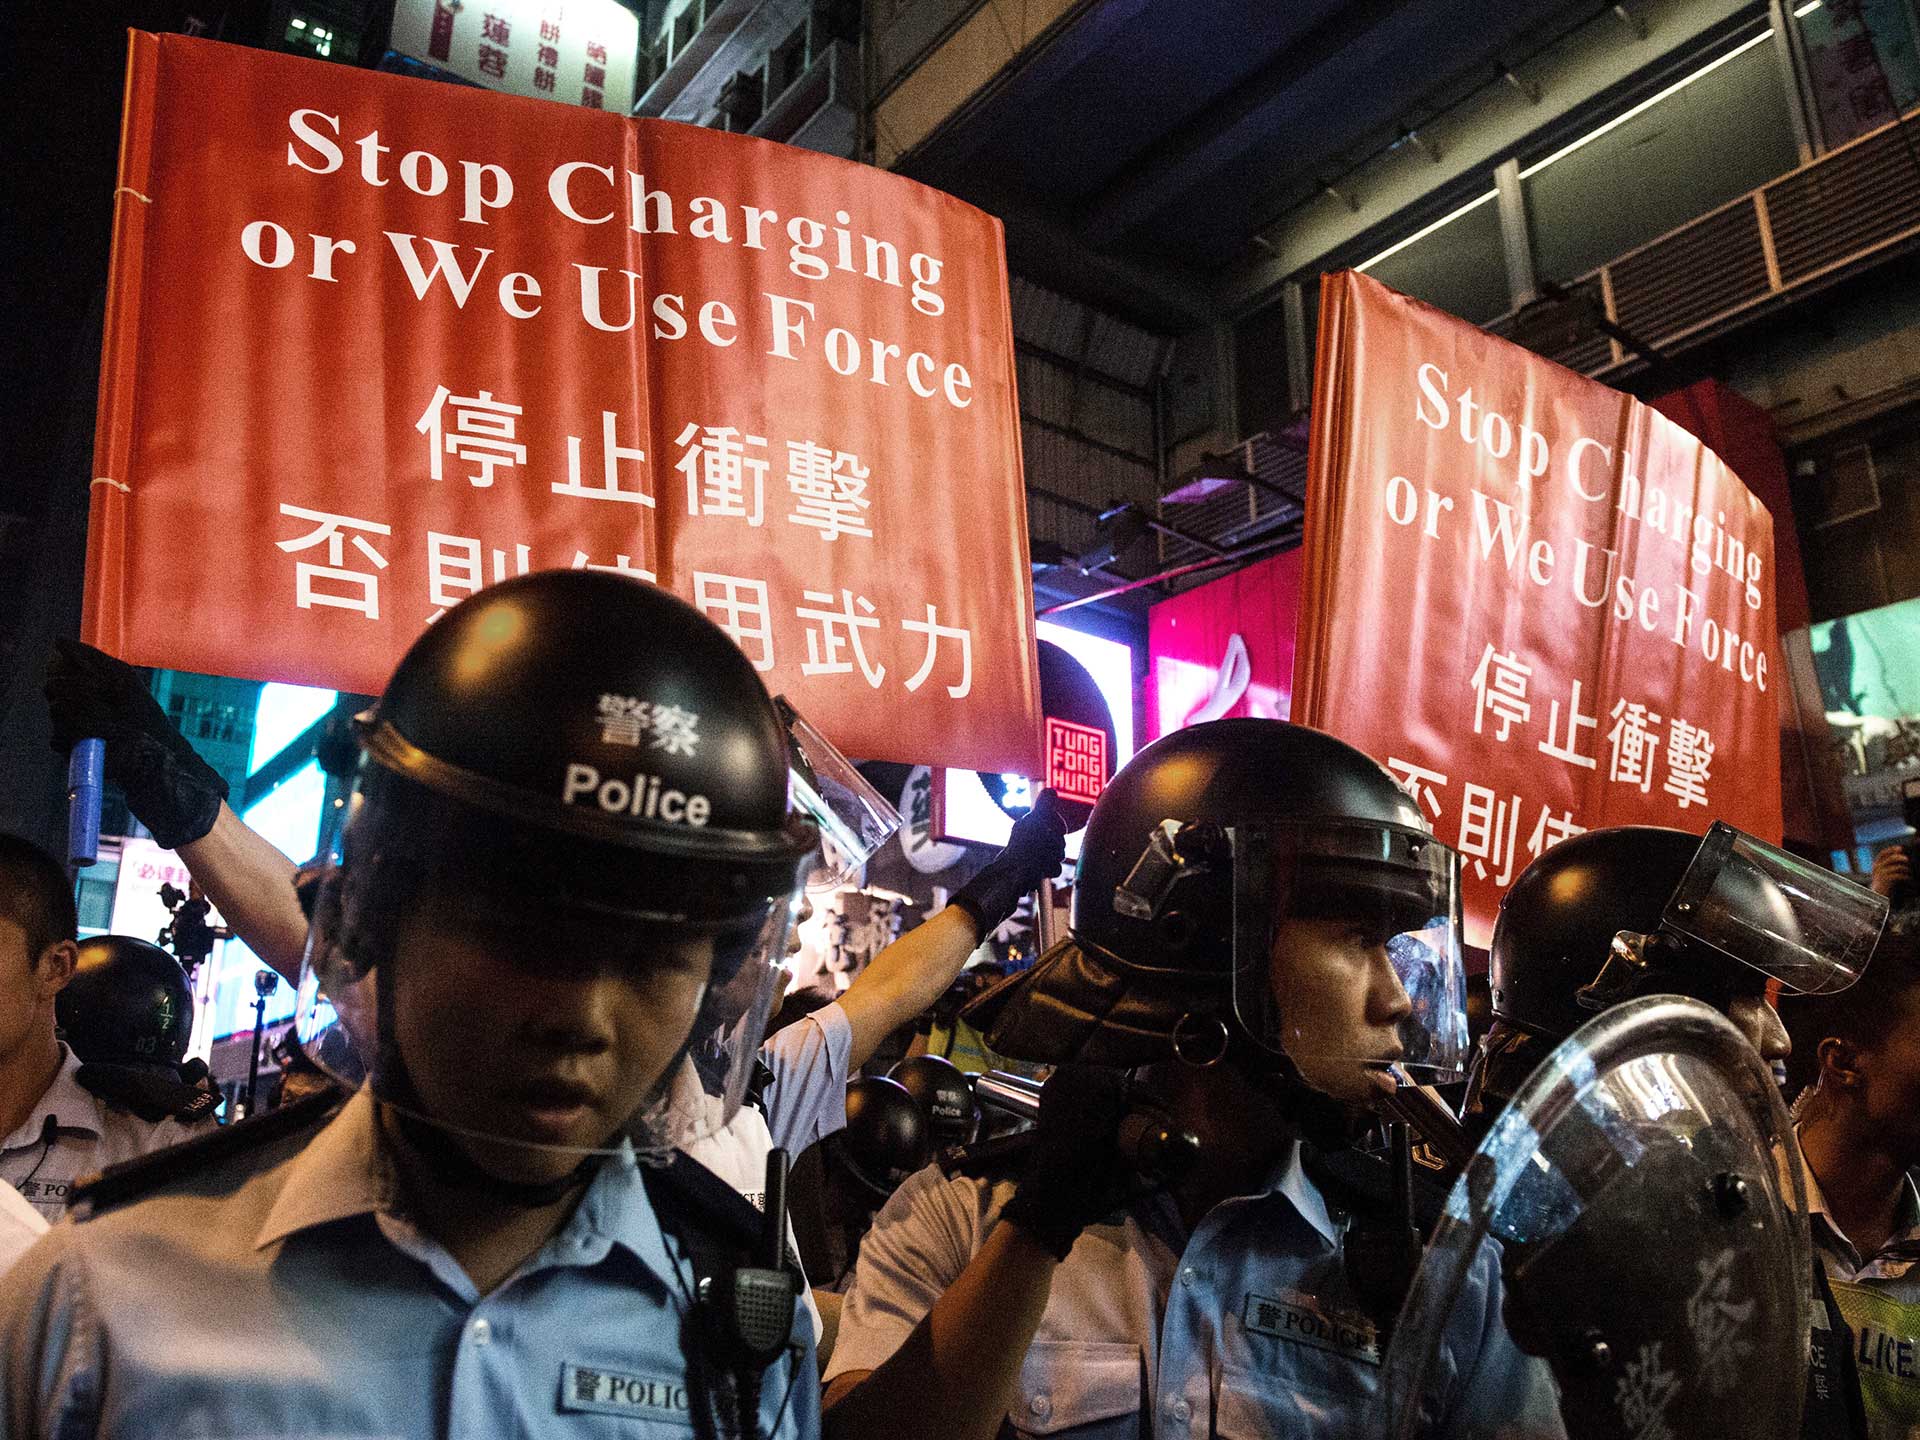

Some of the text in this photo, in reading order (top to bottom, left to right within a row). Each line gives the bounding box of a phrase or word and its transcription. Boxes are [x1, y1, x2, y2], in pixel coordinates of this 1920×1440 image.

[287, 108, 945, 317] Stop Charging
[241, 220, 973, 409] or We Use Force
[415, 384, 873, 542] 停止衝擊
[1416, 363, 1763, 610] Stop Charging
[275, 503, 973, 699] 否則用武力
[1386, 476, 1768, 692] or We Use Force
[595, 692, 700, 758] 警察
[1053, 727, 1101, 757] TUNG
[1470, 642, 1716, 809] 停止衝擊
[563, 763, 712, 829] Police
[1053, 749, 1101, 777] FONG
[1053, 773, 1101, 797] HUNG
[932, 1105, 962, 1118] Police
[44, 1184, 68, 1197] PO
[1860, 1327, 1915, 1378] LICE
[609, 1376, 688, 1412] POLIC
